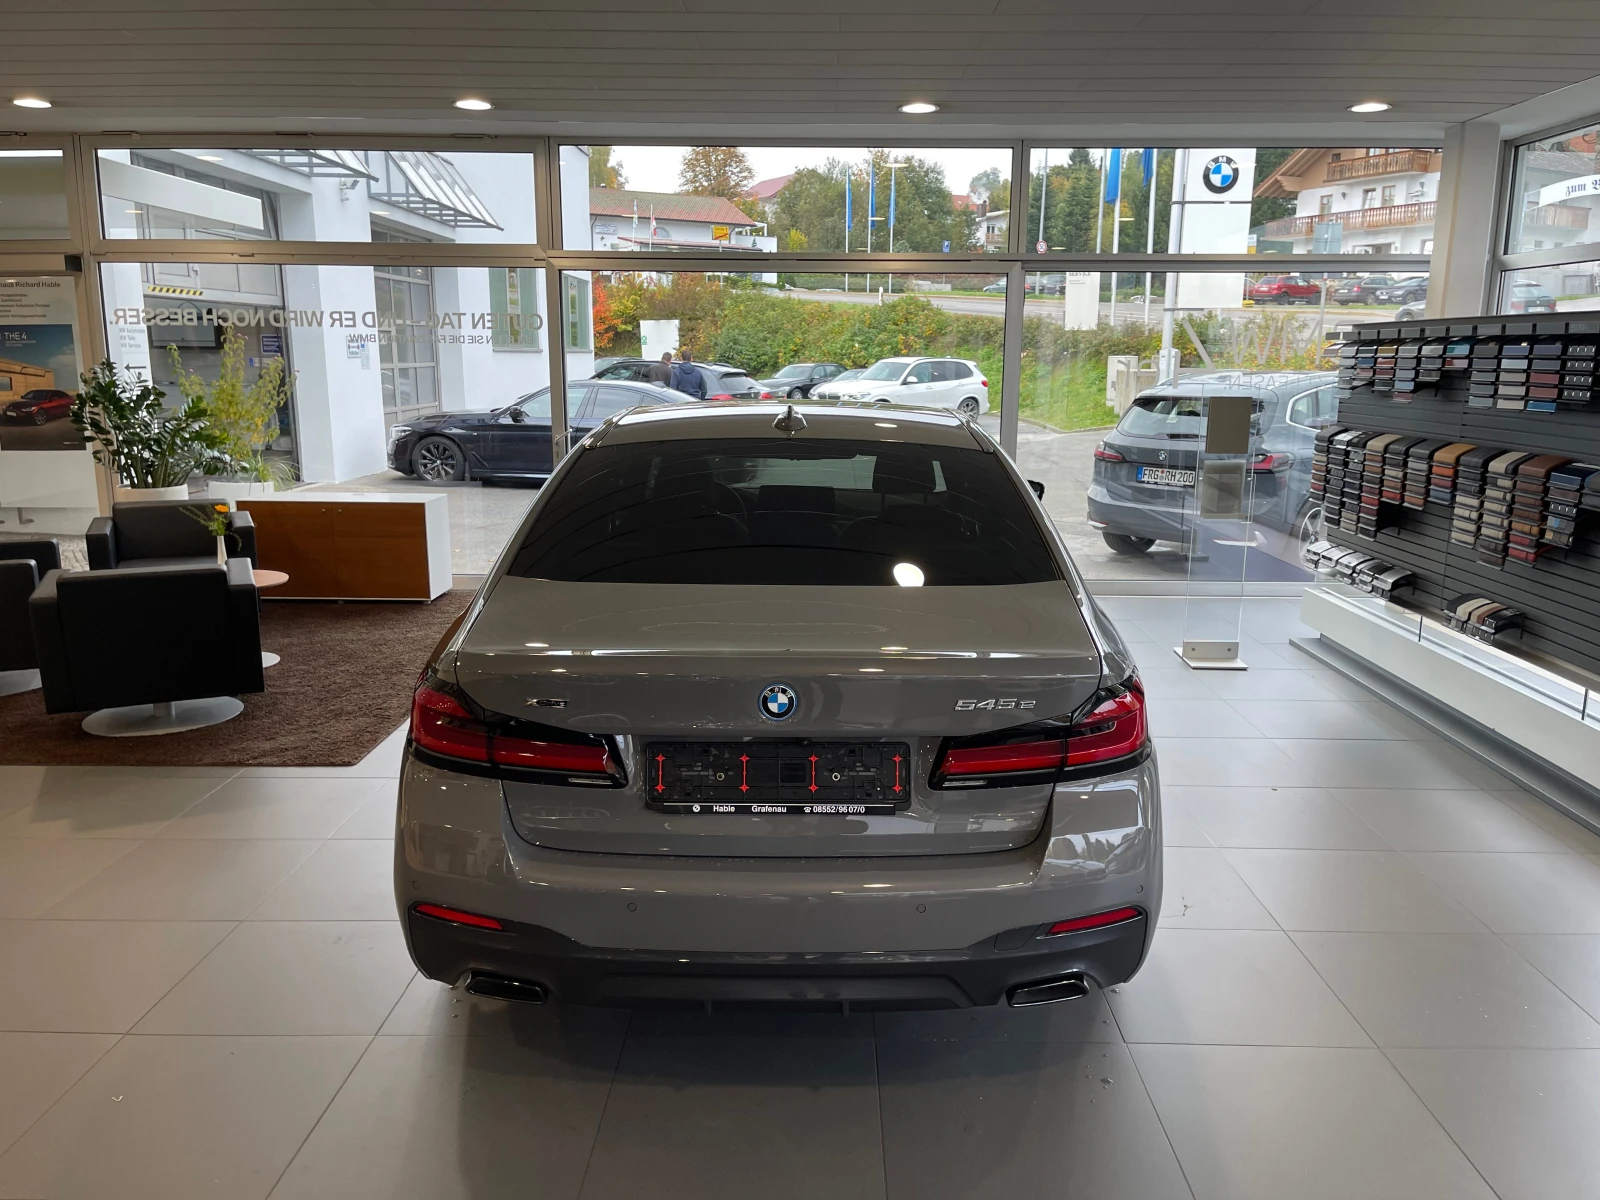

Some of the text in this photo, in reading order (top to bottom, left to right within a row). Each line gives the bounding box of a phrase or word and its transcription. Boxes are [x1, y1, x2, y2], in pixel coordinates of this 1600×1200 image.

[1206, 156, 1239, 169] BMW
[1565, 183, 1586, 197] zum
[4, 331, 27, 340] THE 4
[1142, 468, 1160, 480] FRG
[1164, 470, 1177, 482] RH
[1177, 471, 1194, 484] 200
[954, 698, 1036, 711] 545e
[713, 804, 736, 813] Hable
[751, 804, 787, 813] Grafenau
